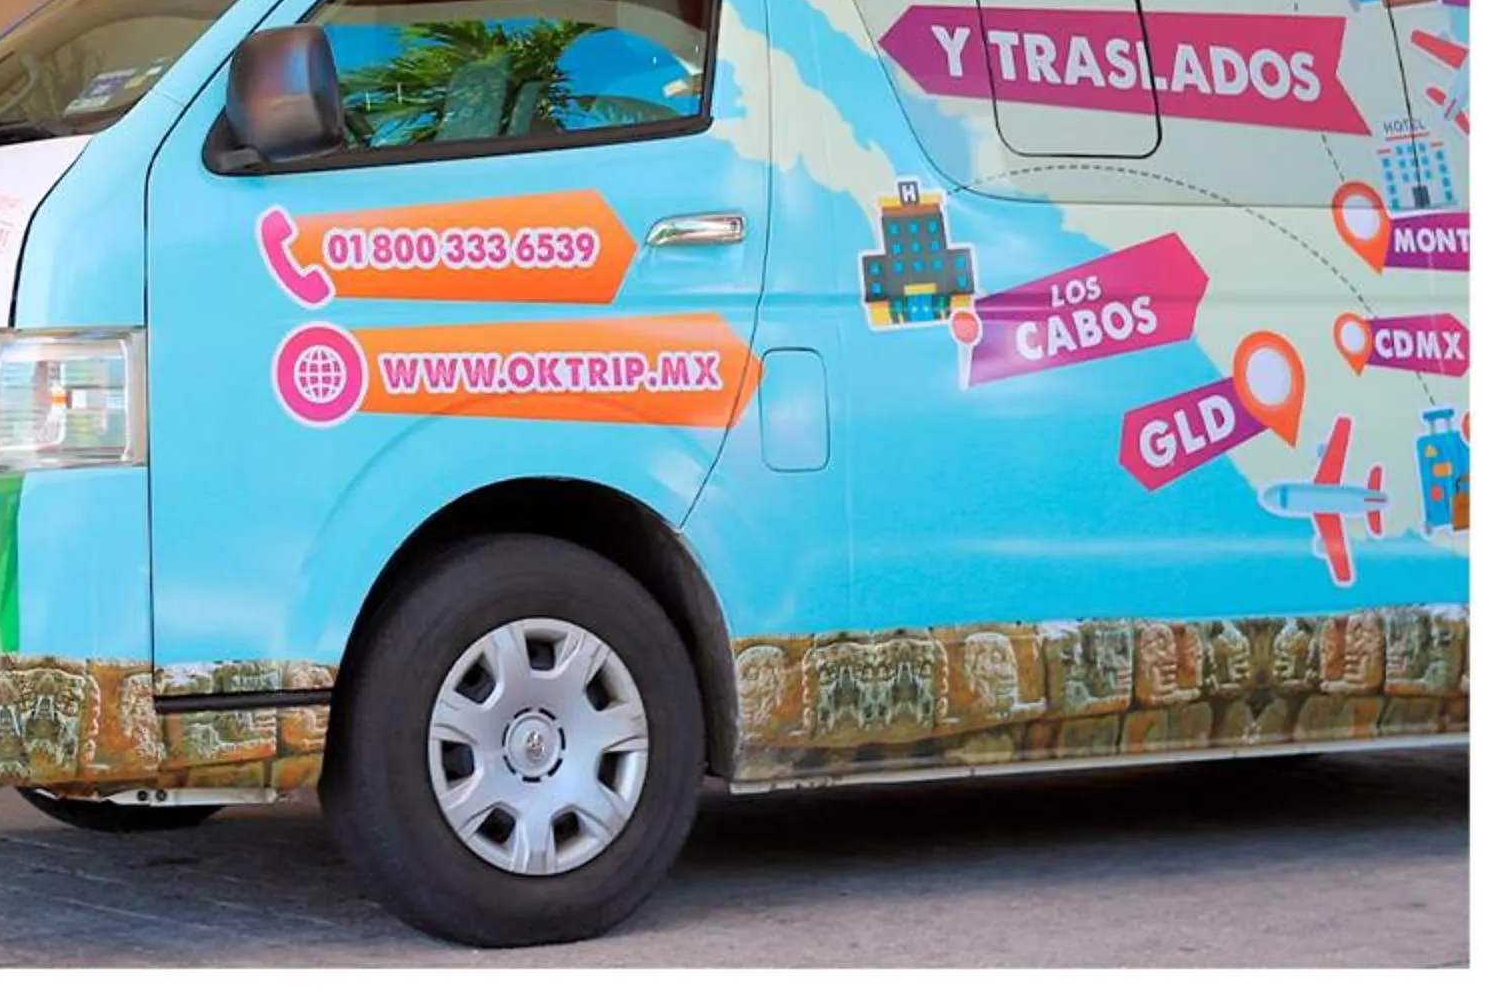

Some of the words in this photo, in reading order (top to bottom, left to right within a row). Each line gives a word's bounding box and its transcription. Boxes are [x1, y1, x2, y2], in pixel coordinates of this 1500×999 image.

[931, 24, 971, 78] Y
[987, 31, 1322, 102] TRASLADOS
[1383, 119, 1427, 134] HOTEL
[901, 184, 917, 202] H
[326, 232, 363, 266] 01
[373, 231, 437, 265] 800
[445, 231, 508, 265] 333
[514, 230, 597, 264] 6539
[1050, 276, 1102, 307] LOS
[1015, 296, 1159, 362] CABOS
[1374, 327, 1465, 361] CDMX
[381, 352, 720, 392] WWW.OKTRIP.MX
[1138, 393, 1237, 469] GLD
